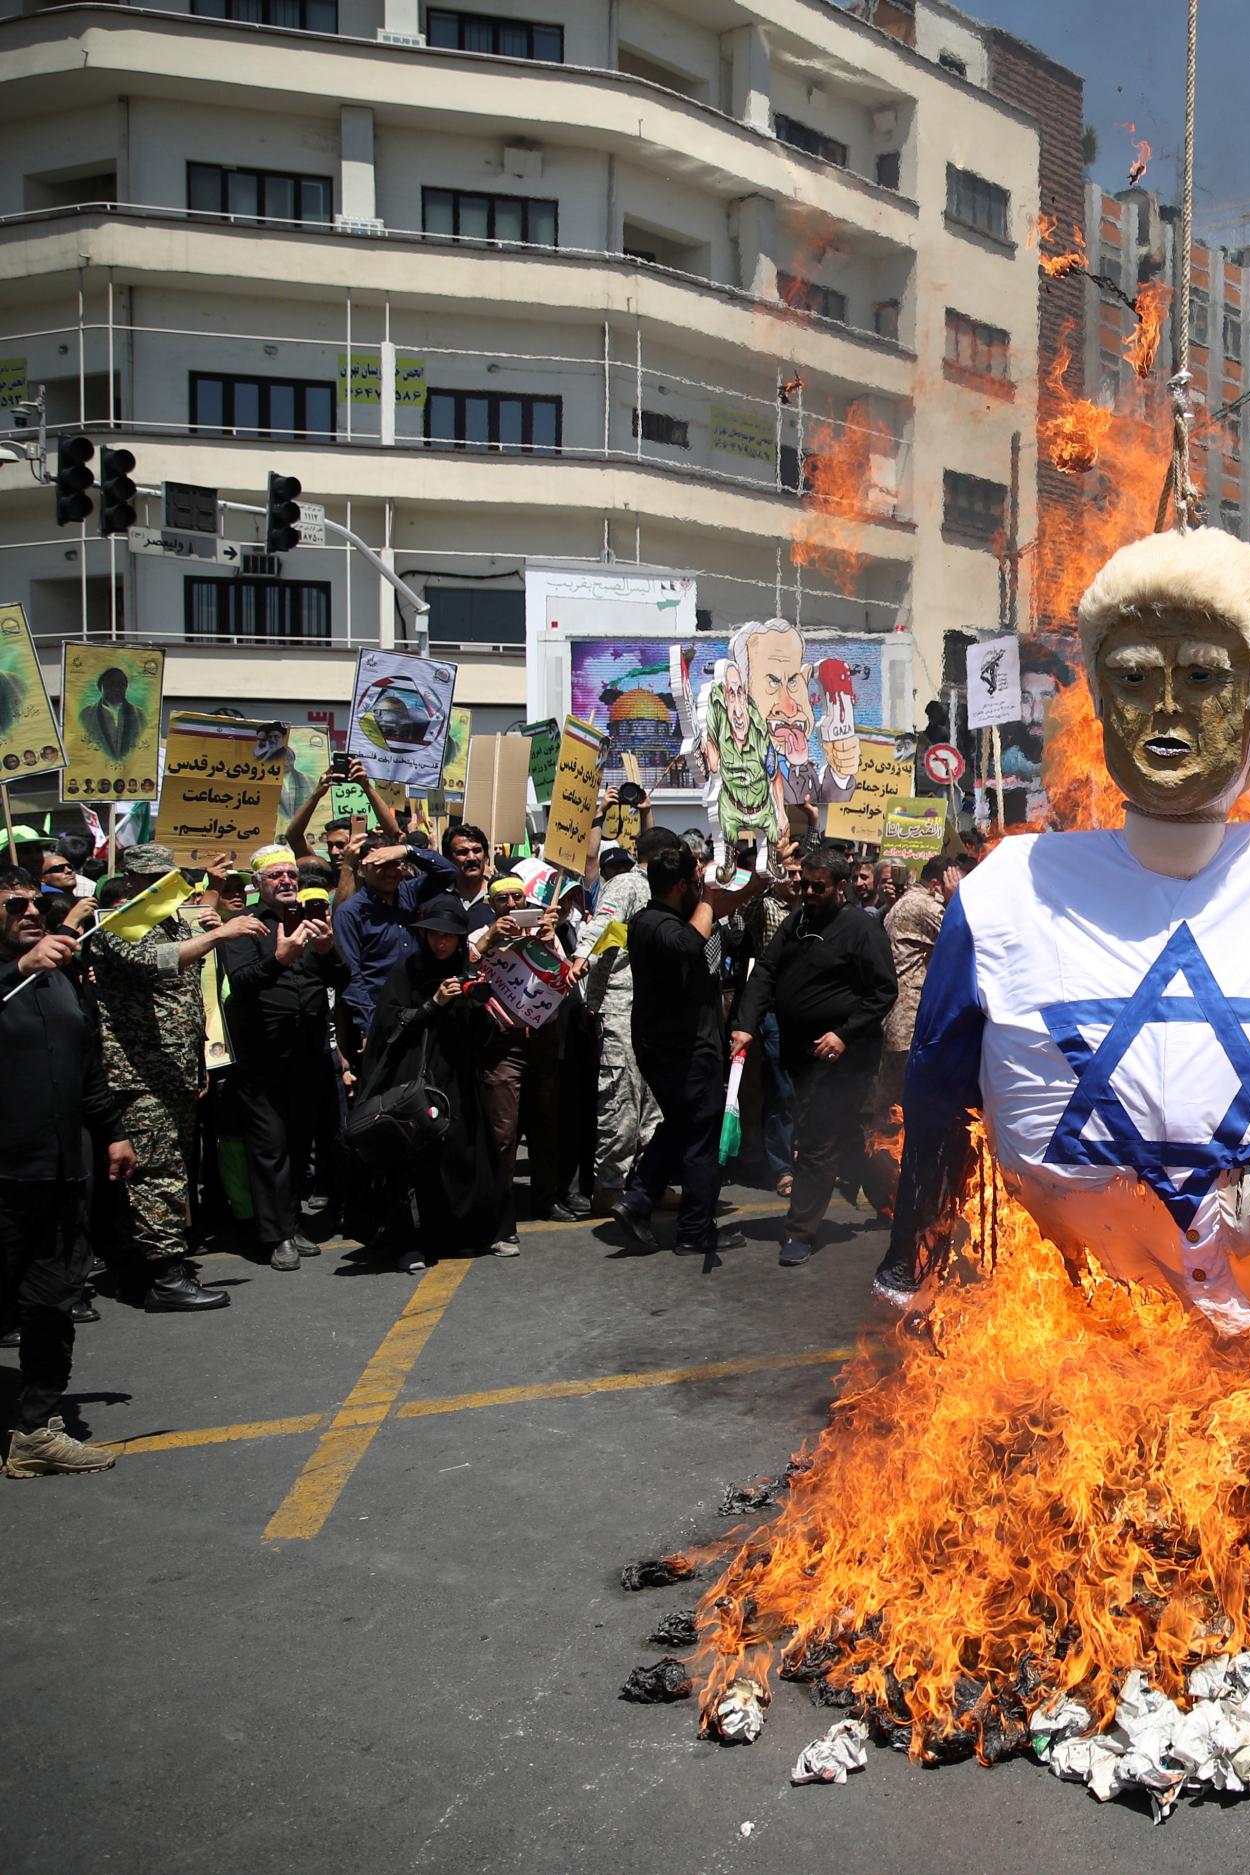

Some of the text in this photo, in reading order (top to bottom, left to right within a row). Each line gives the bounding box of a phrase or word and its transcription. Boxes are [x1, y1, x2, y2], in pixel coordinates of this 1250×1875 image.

[833, 724, 852, 736] GAZA
[168, 755, 281, 781] به زودی در قدس
[560, 757, 577, 772] قدس
[863, 761, 912, 776] به زودی در
[856, 779, 898, 798] نماز جماع
[183, 788, 261, 810] نماز جماعت
[562, 788, 582, 808] جماعت
[899, 822, 942, 839] القدس
[508, 976, 524, 989] بر
[494, 977, 516, 1003] WITH
[515, 1002, 541, 1024] U.S.A
